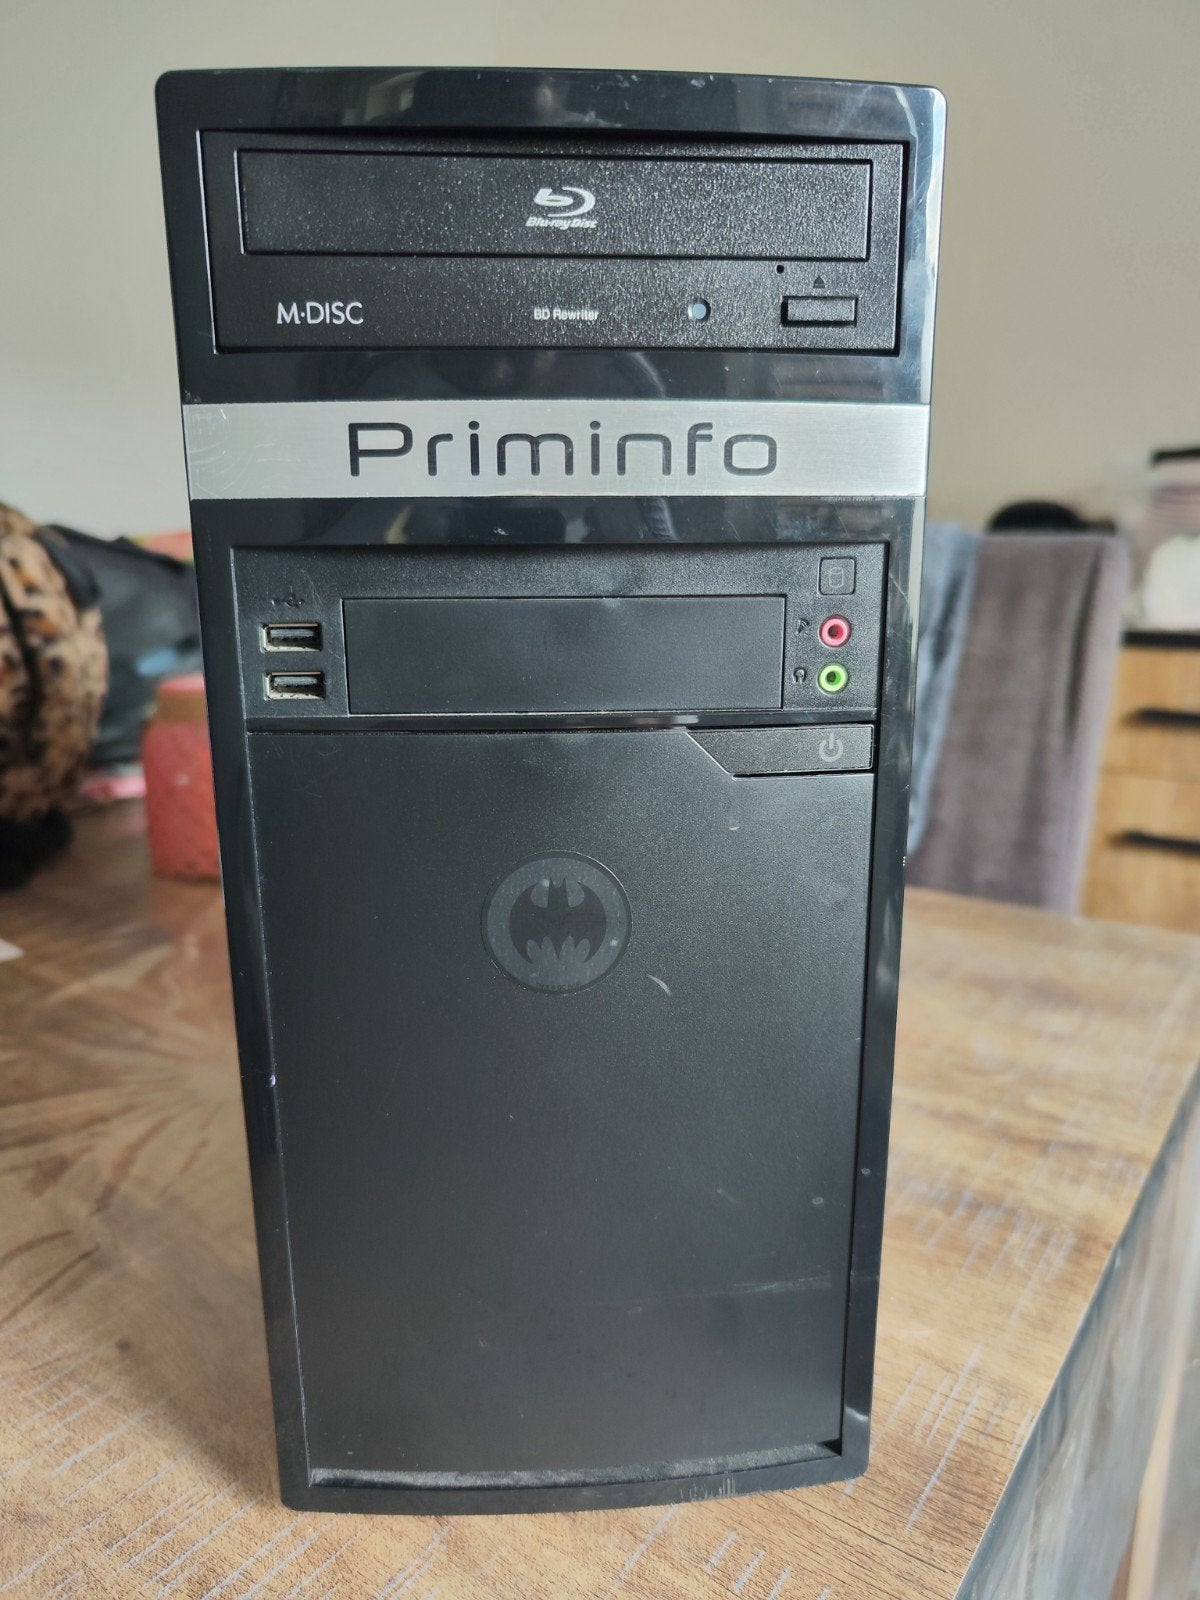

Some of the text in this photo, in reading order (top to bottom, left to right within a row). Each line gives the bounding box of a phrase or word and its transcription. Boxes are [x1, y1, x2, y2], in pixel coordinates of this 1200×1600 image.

[534, 307, 599, 321] BD Rewriter
[348, 420, 778, 477] Priminfo
